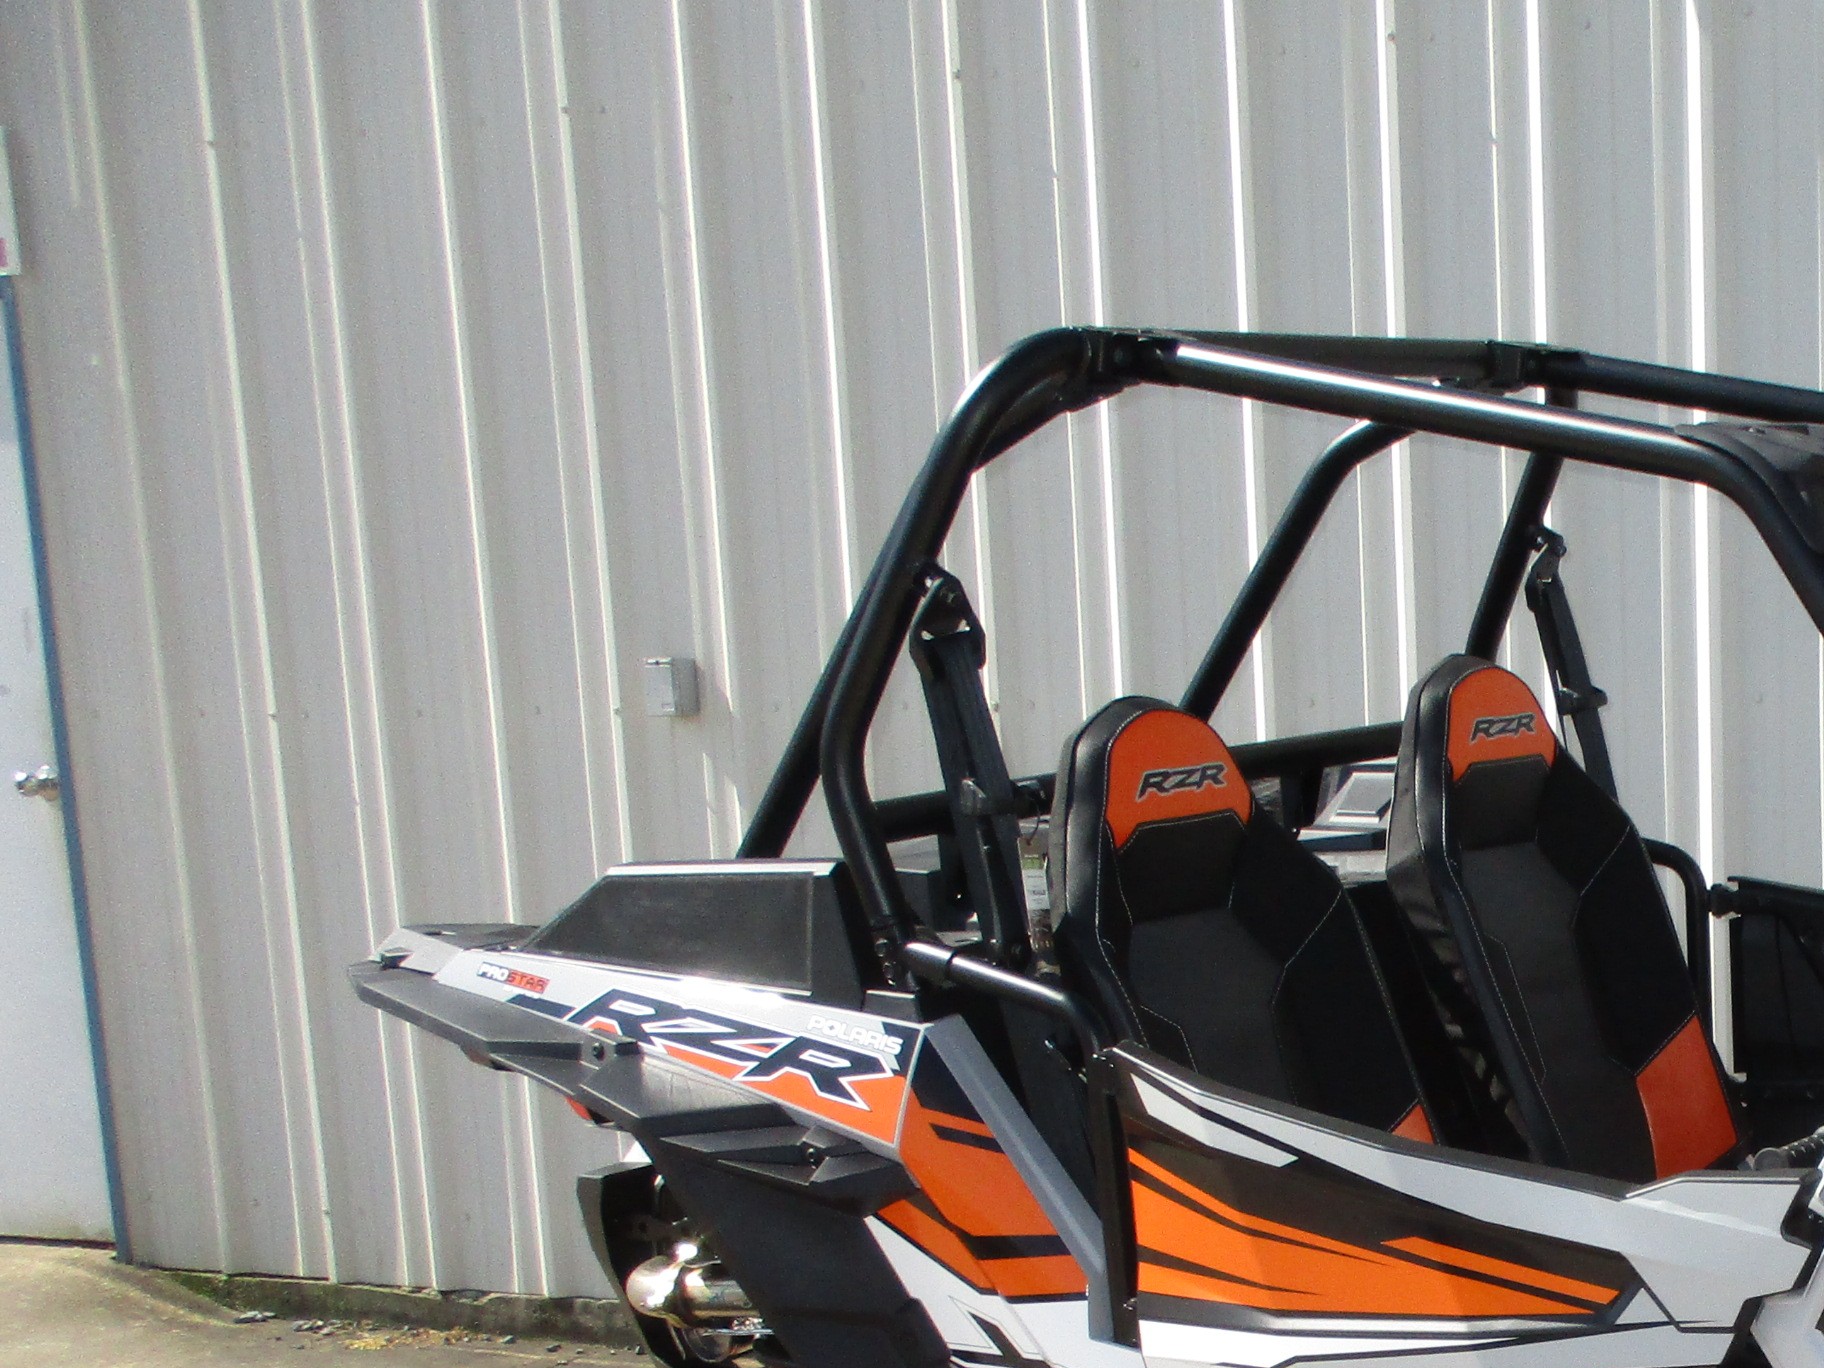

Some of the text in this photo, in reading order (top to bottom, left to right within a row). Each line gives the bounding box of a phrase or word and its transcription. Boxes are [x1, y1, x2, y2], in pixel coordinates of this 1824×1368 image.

[1469, 713, 1535, 743] RZR
[1137, 762, 1228, 802] RZR
[567, 989, 896, 1112] RZR
[806, 1015, 904, 1055] POLARIS
